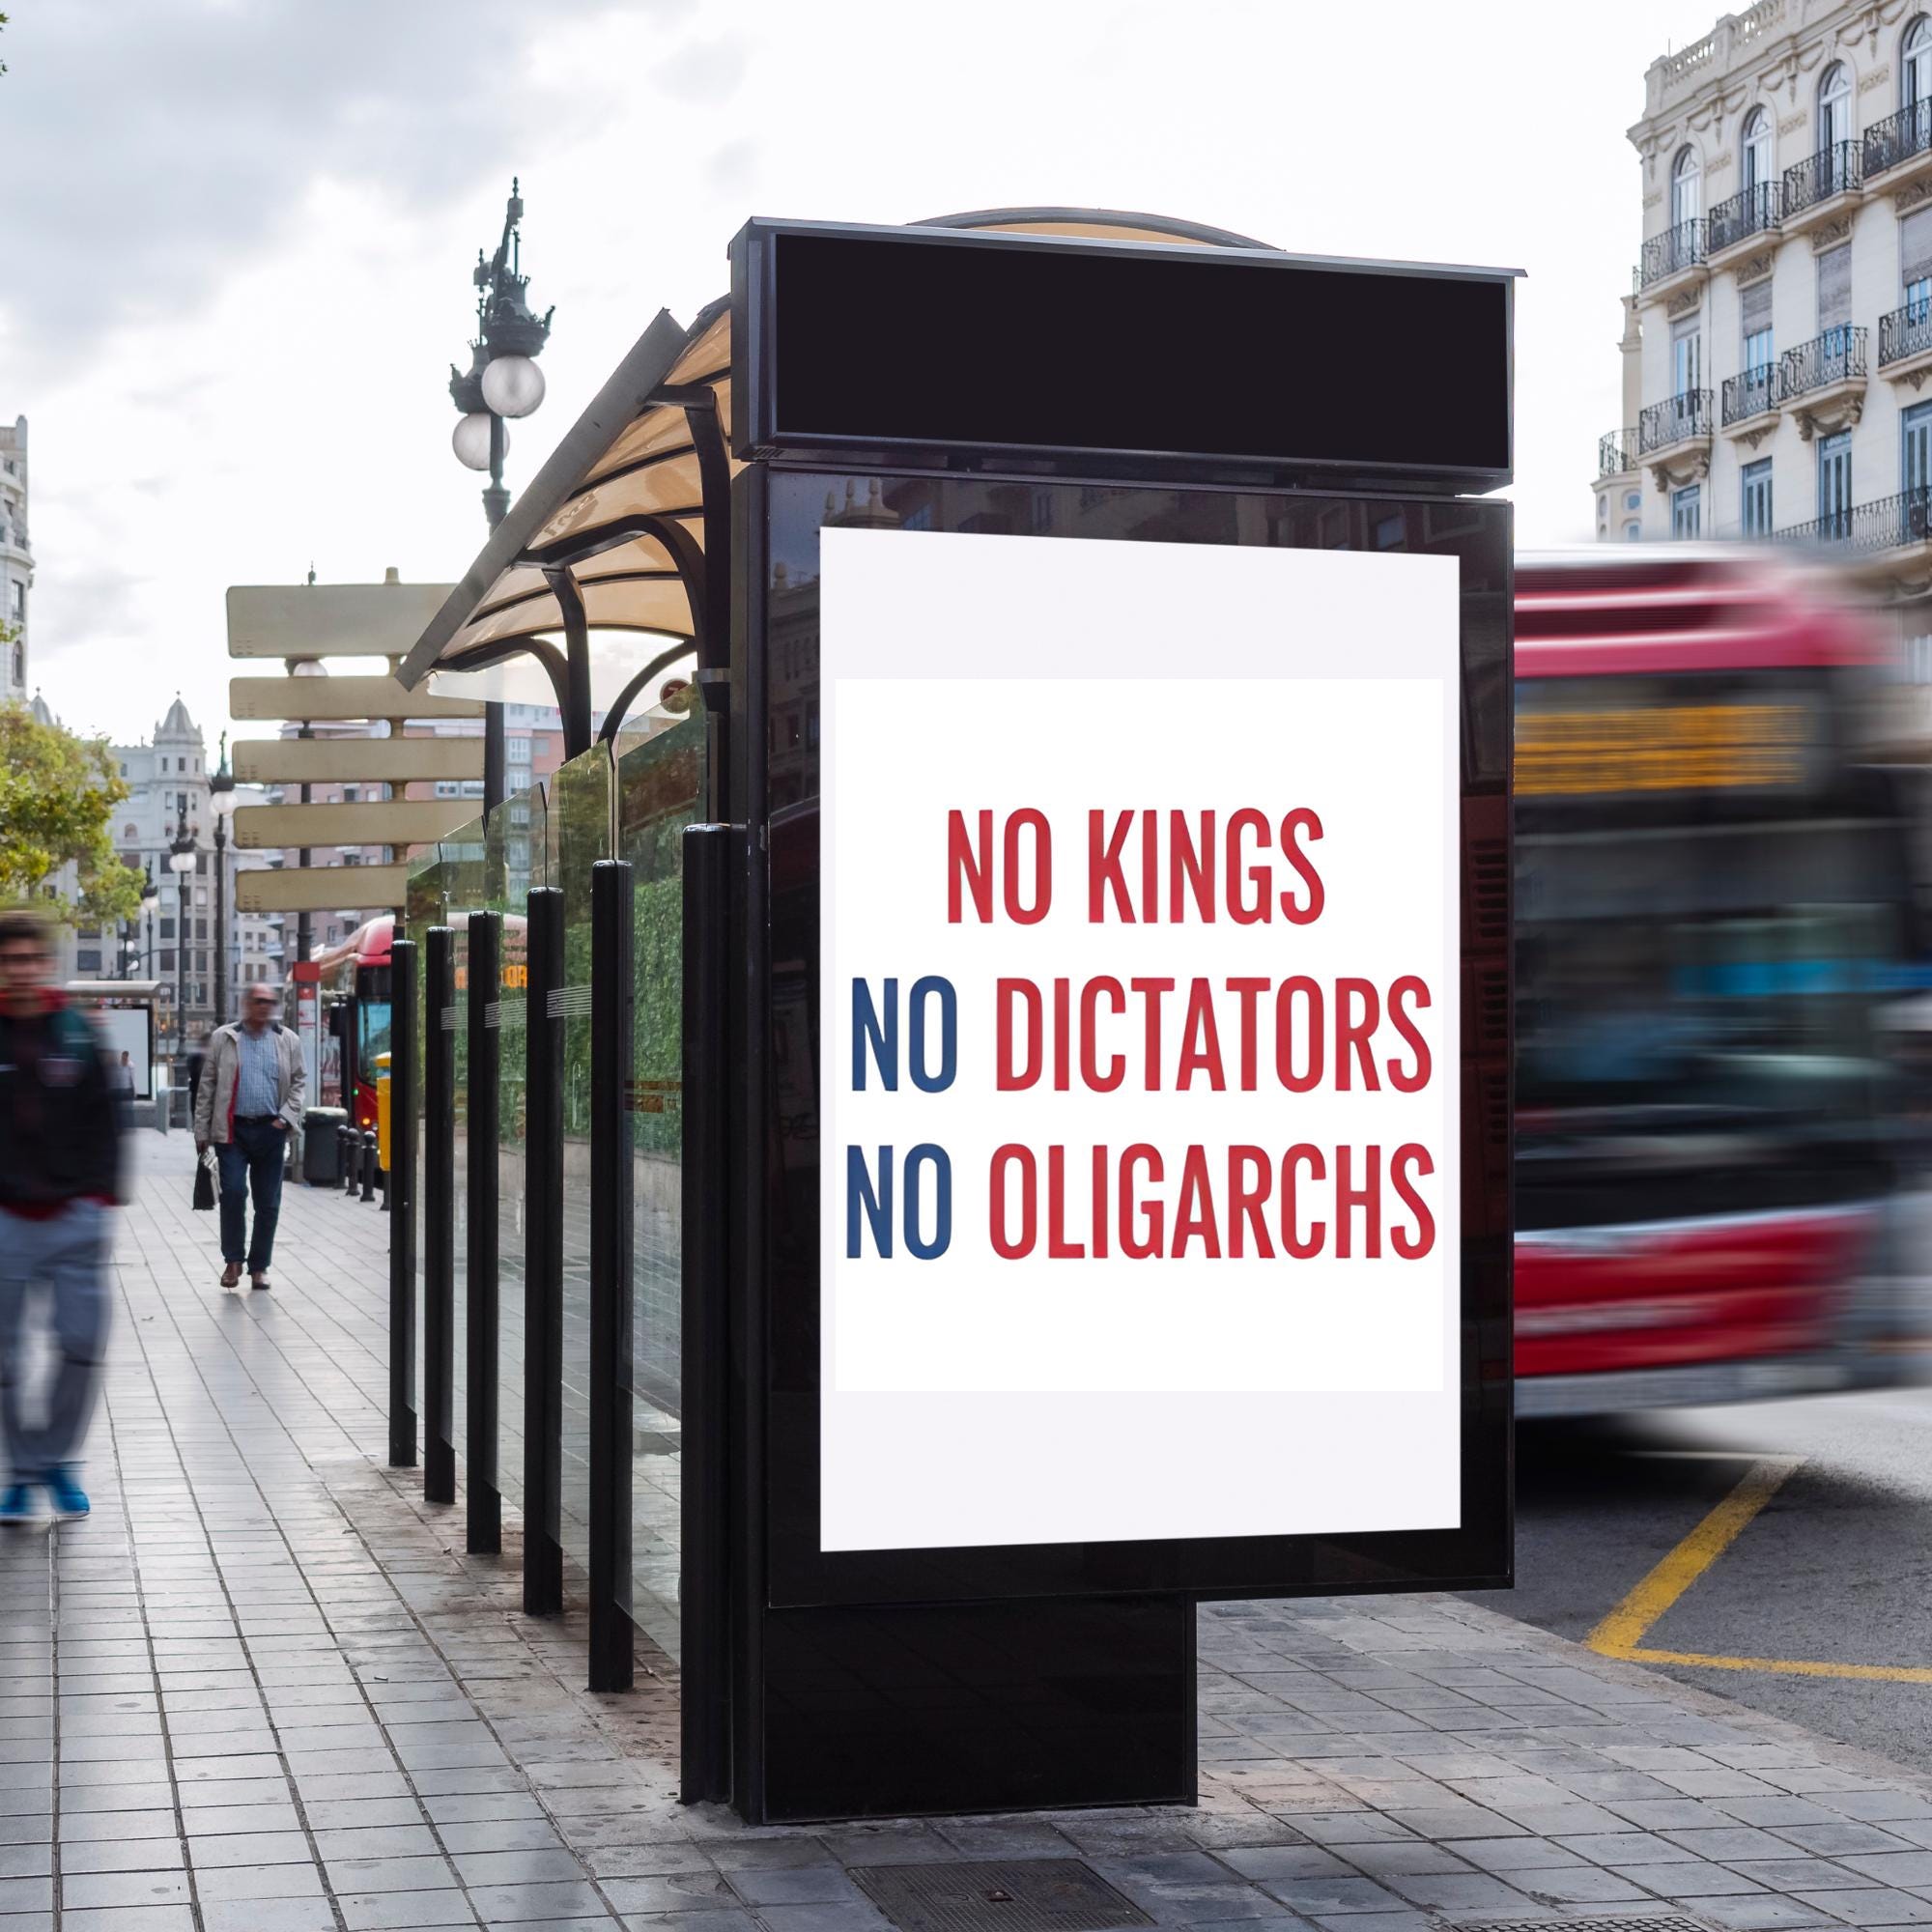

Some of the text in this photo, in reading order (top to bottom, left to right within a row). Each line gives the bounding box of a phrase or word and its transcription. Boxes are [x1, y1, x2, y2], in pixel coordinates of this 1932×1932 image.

[949, 808, 1325, 925] NO KINGS
[852, 976, 1433, 1093] NO DICTATORS
[847, 1143, 1436, 1260] NO OLIGARCHS
